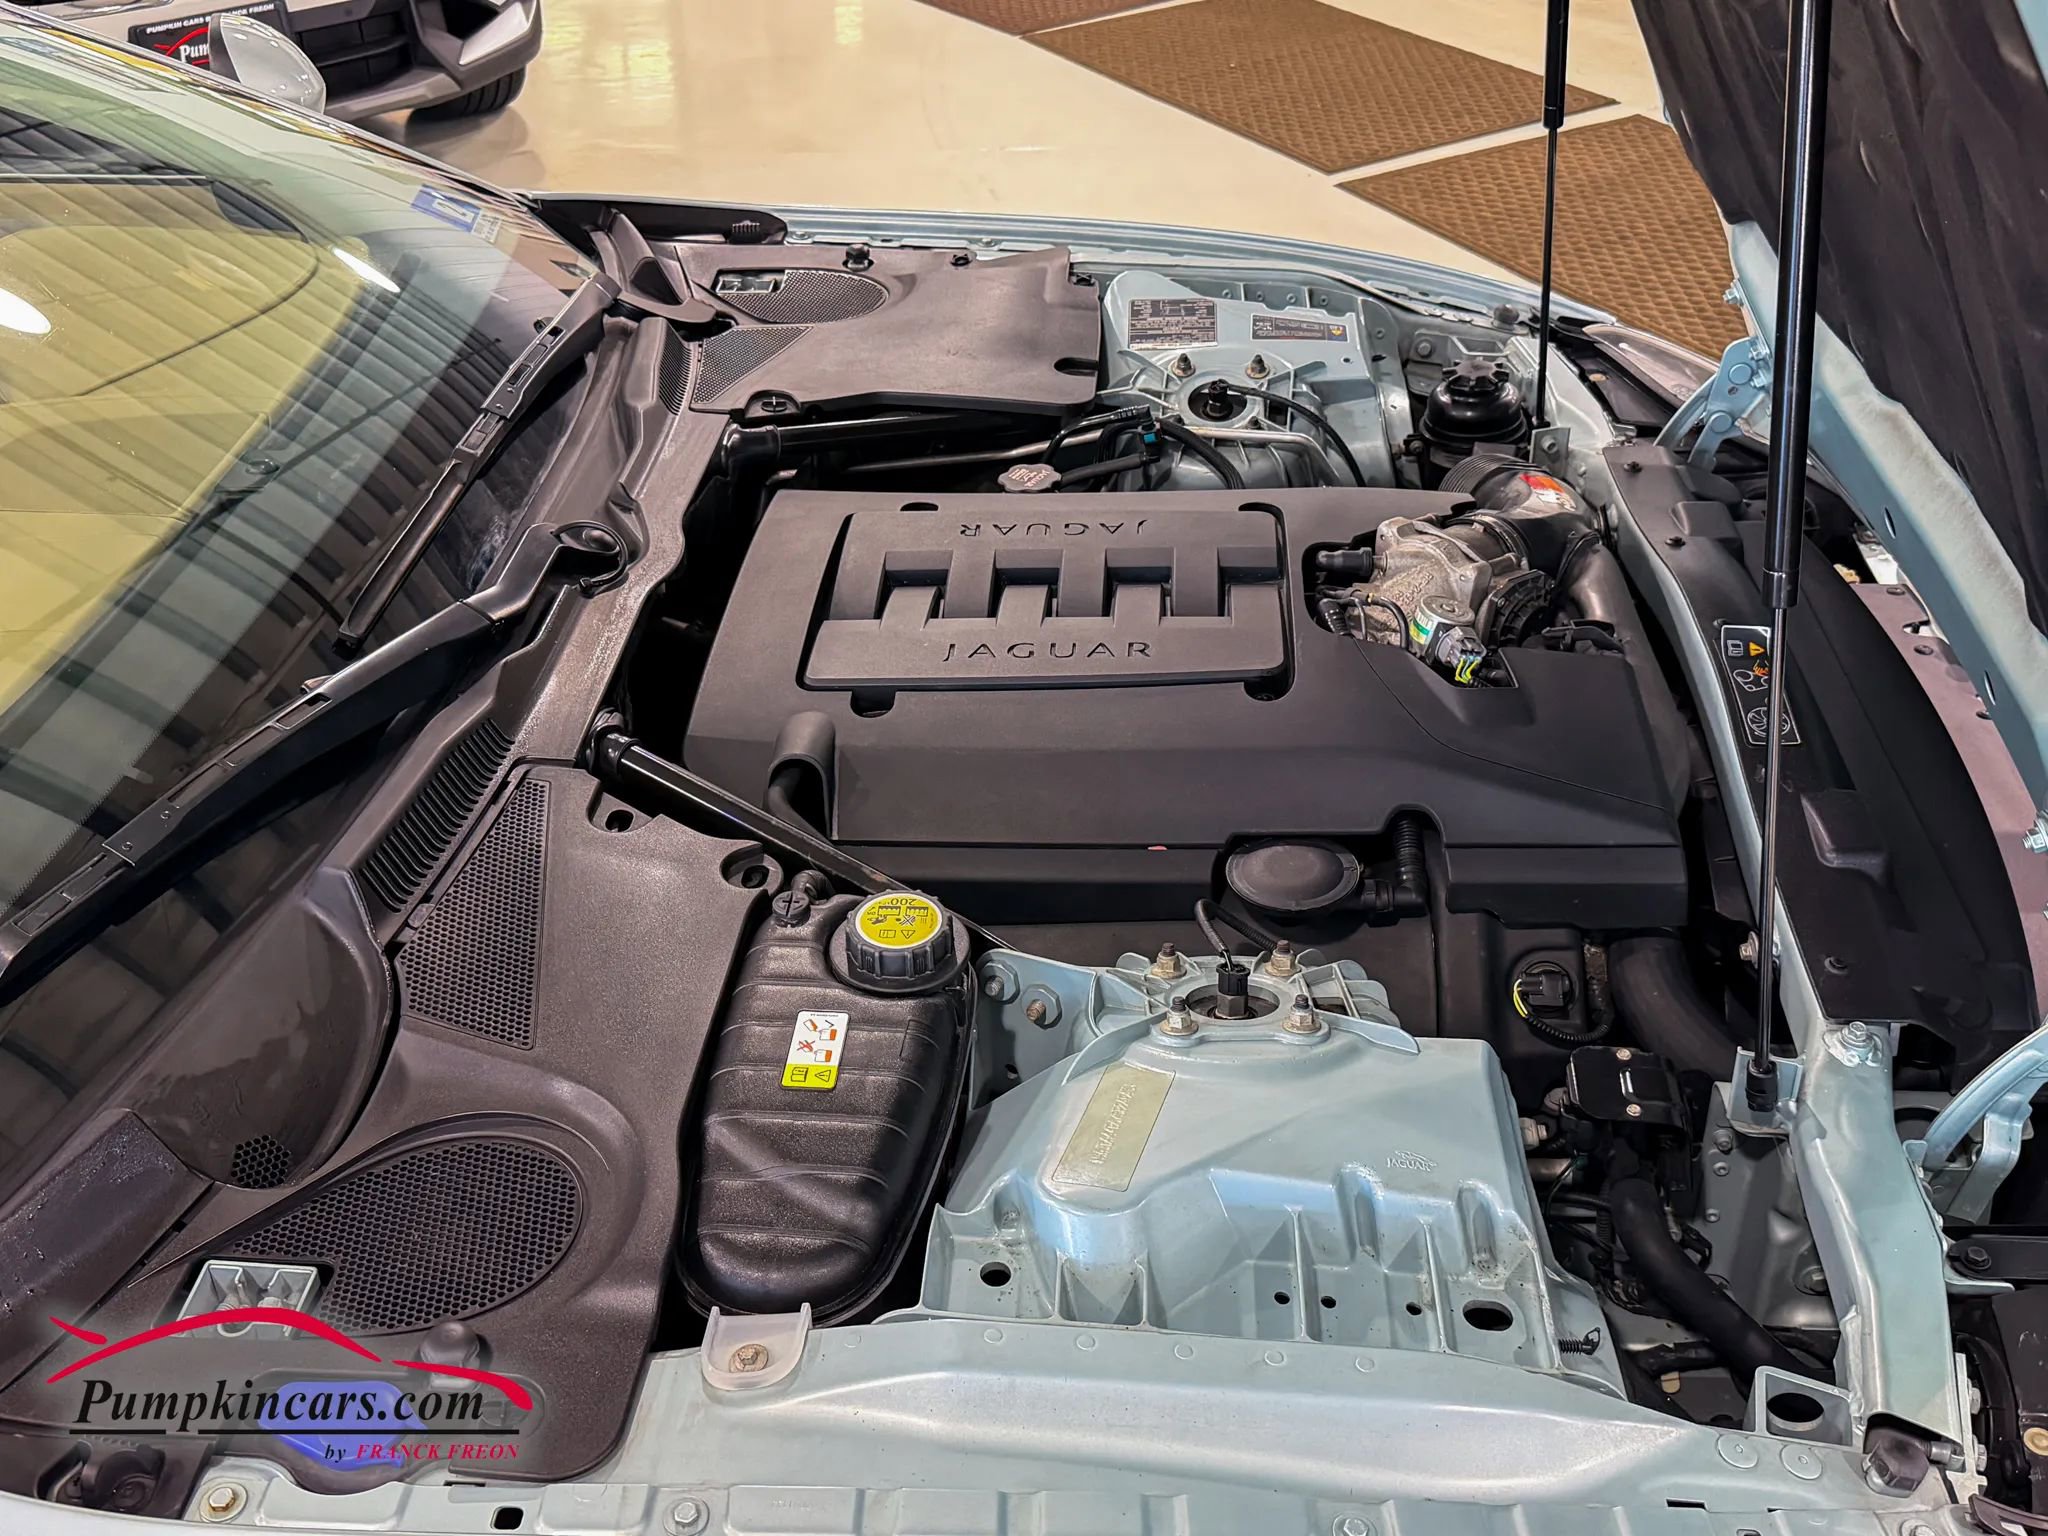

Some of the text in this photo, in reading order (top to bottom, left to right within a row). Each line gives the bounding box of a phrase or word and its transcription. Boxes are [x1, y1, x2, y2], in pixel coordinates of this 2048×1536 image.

[146, 21, 182, 34] PUMPKIN
[183, 17, 204, 26] CARS
[960, 518, 1149, 537] JAGUAR
[942, 642, 1151, 662] JAGUAR
[891, 898, 917, 906] 200
[1386, 1158, 1431, 1172] JAGUAR
